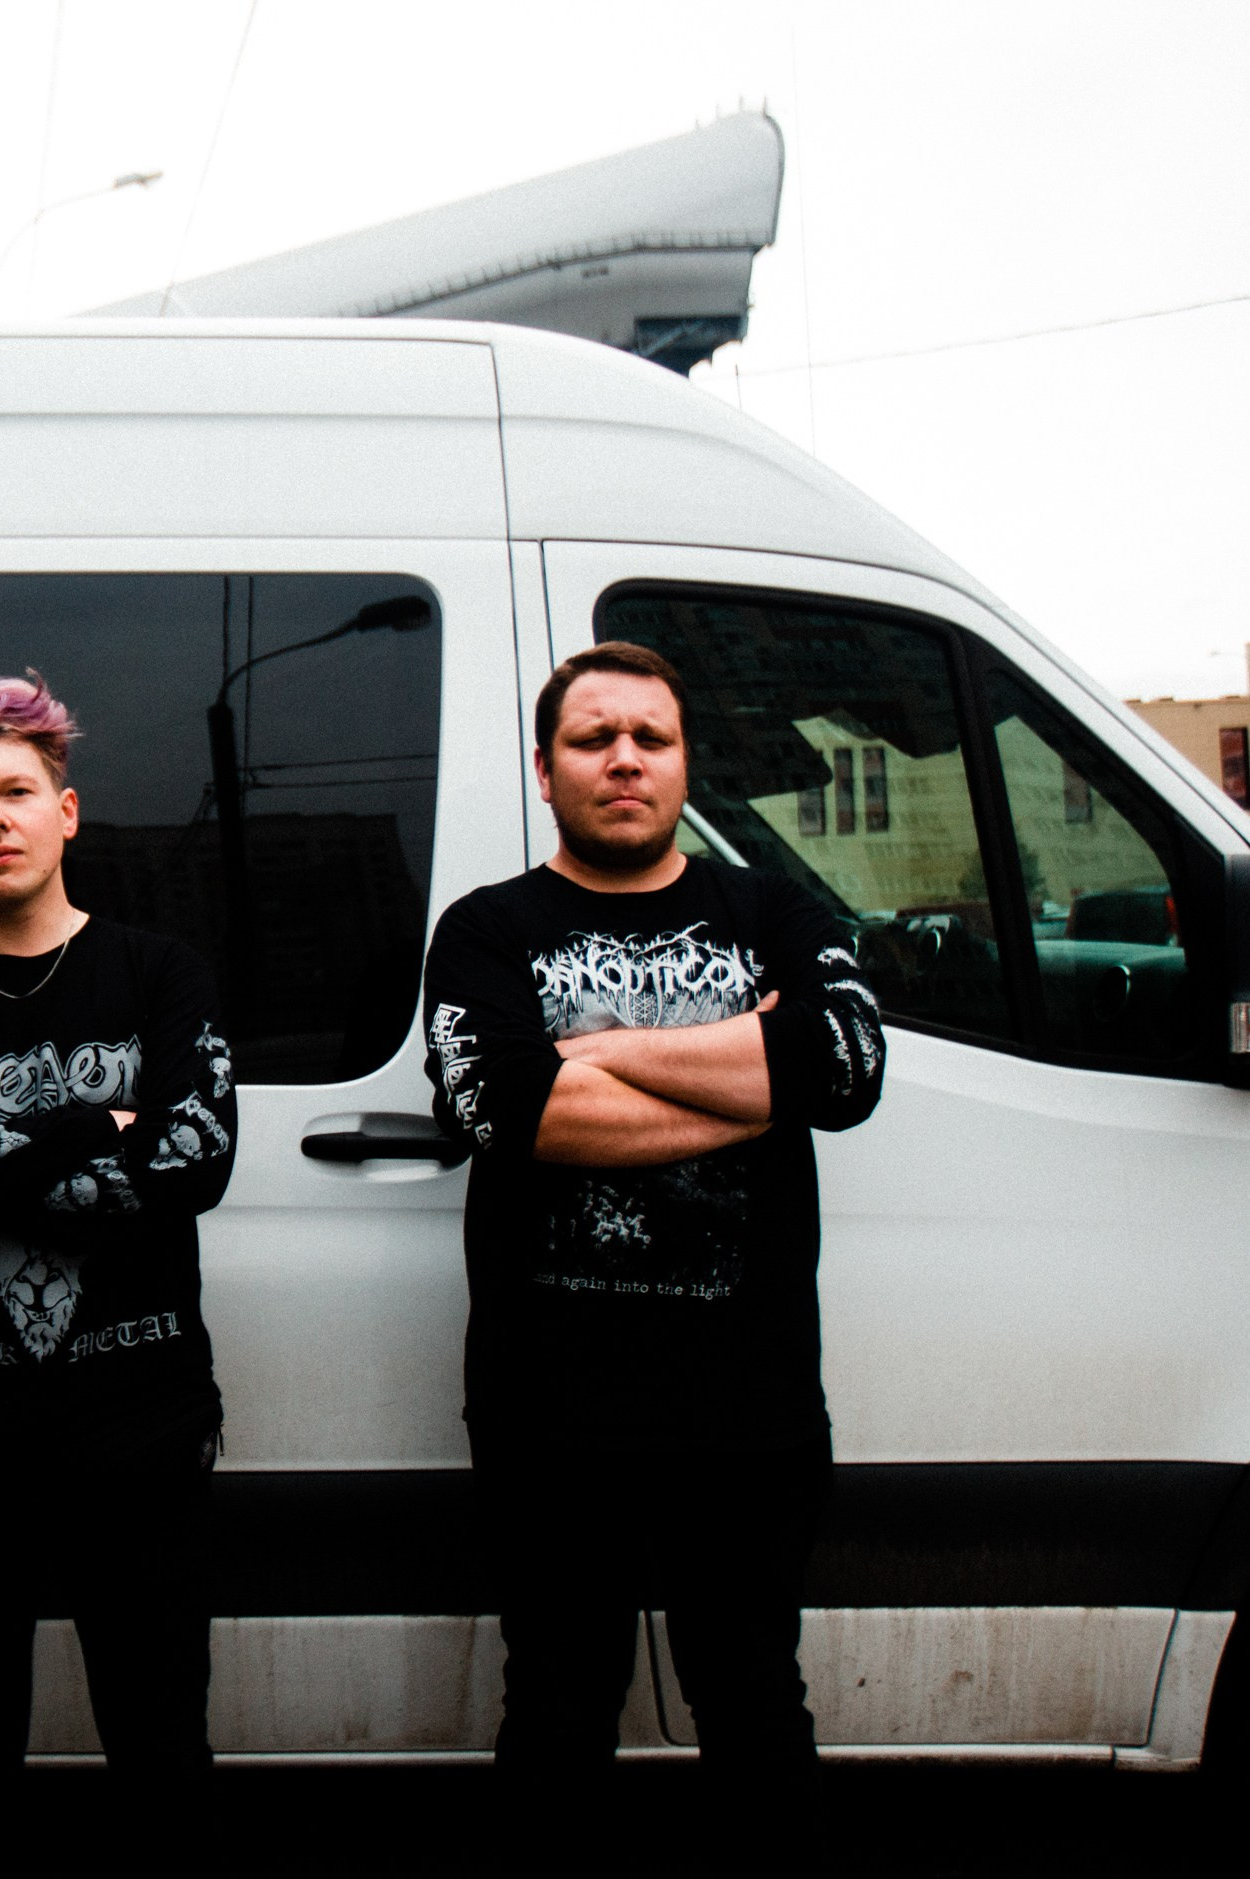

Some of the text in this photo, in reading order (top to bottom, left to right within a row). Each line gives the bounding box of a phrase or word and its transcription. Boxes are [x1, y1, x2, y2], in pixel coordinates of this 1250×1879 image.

[561, 1276, 606, 1291] again
[614, 1279, 649, 1293] into
[657, 1282, 683, 1296] the
[690, 1283, 731, 1301] light
[67, 1311, 182, 1363] METAL
